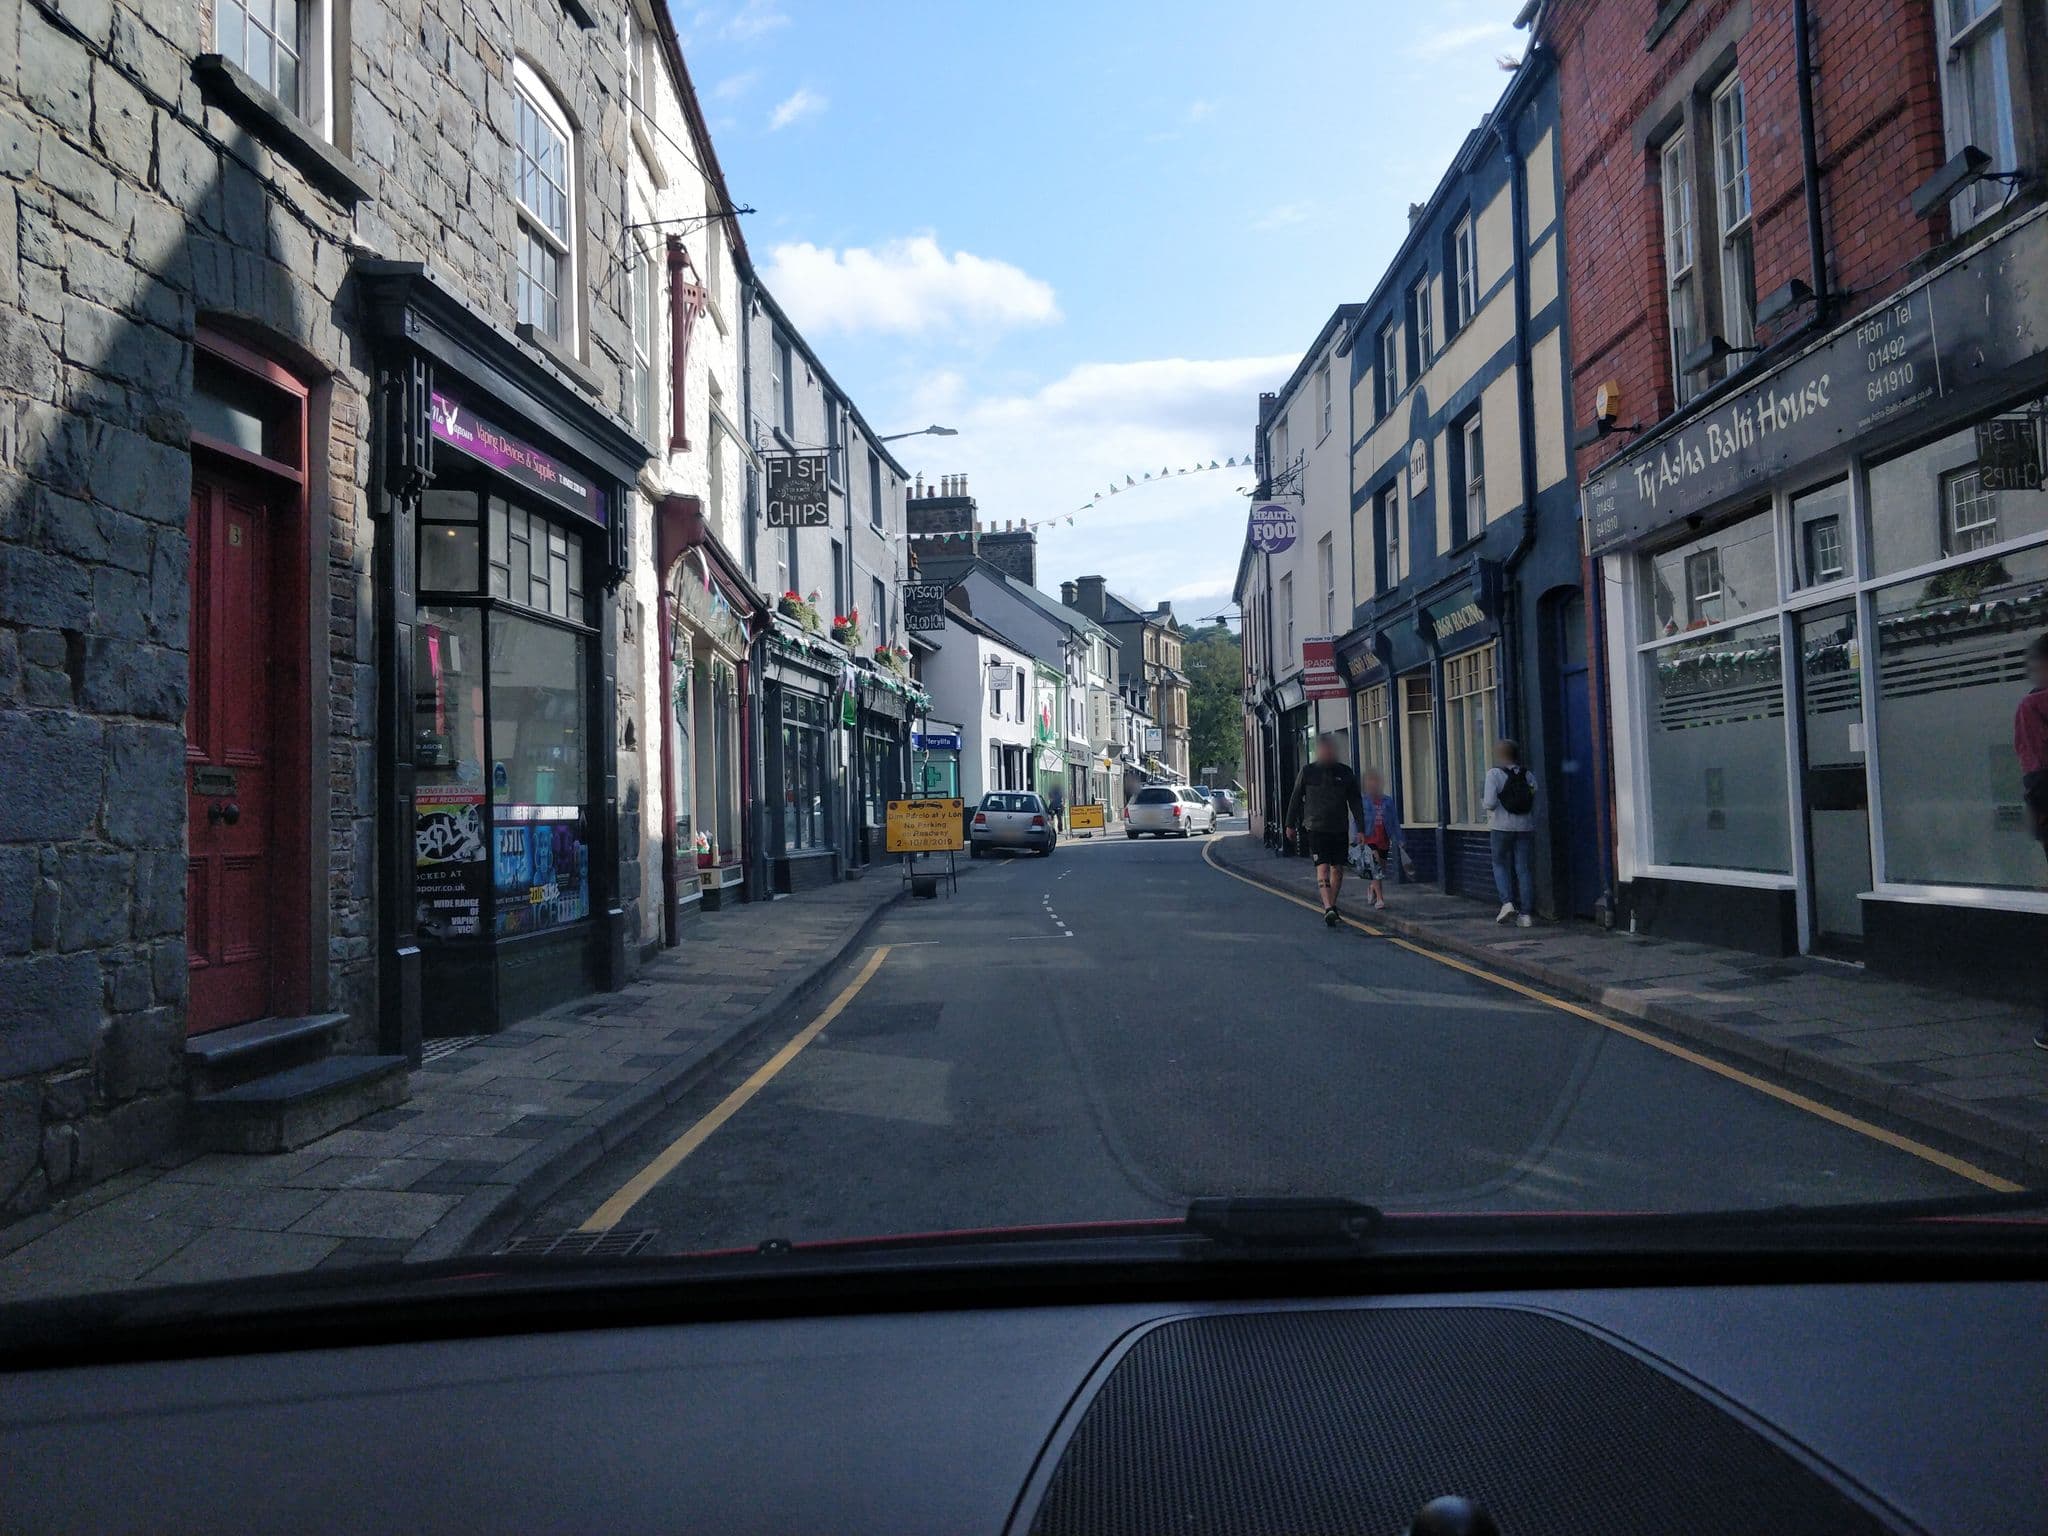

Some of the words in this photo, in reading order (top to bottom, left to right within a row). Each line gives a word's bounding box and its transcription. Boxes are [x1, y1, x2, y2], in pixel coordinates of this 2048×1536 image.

[1857, 320, 1884, 349] Ffôn
[1894, 299, 1912, 328] Tel
[1868, 335, 1906, 372] 01492
[1868, 362, 1914, 402] 641910
[1659, 438, 1706, 492] Asha
[1706, 406, 1754, 464] Balti
[1757, 374, 1831, 438] House
[476, 421, 499, 454] Vaping
[500, 436, 525, 465] Devices
[526, 452, 532, 468] &
[533, 456, 557, 482] Supplies
[768, 458, 827, 491] FISH
[768, 501, 828, 525] CHIPS
[1254, 510, 1294, 521] HEALTH
[1253, 522, 1297, 541] FOOD
[1596, 515, 1618, 537] 641910
[903, 585, 943, 607] PYSGOD
[904, 613, 945, 630] SGLODION
[450, 870, 462, 878] AT
[433, 899, 454, 908] WIDE
[455, 898, 479, 907] RANGE
[470, 907, 479, 916] OF
